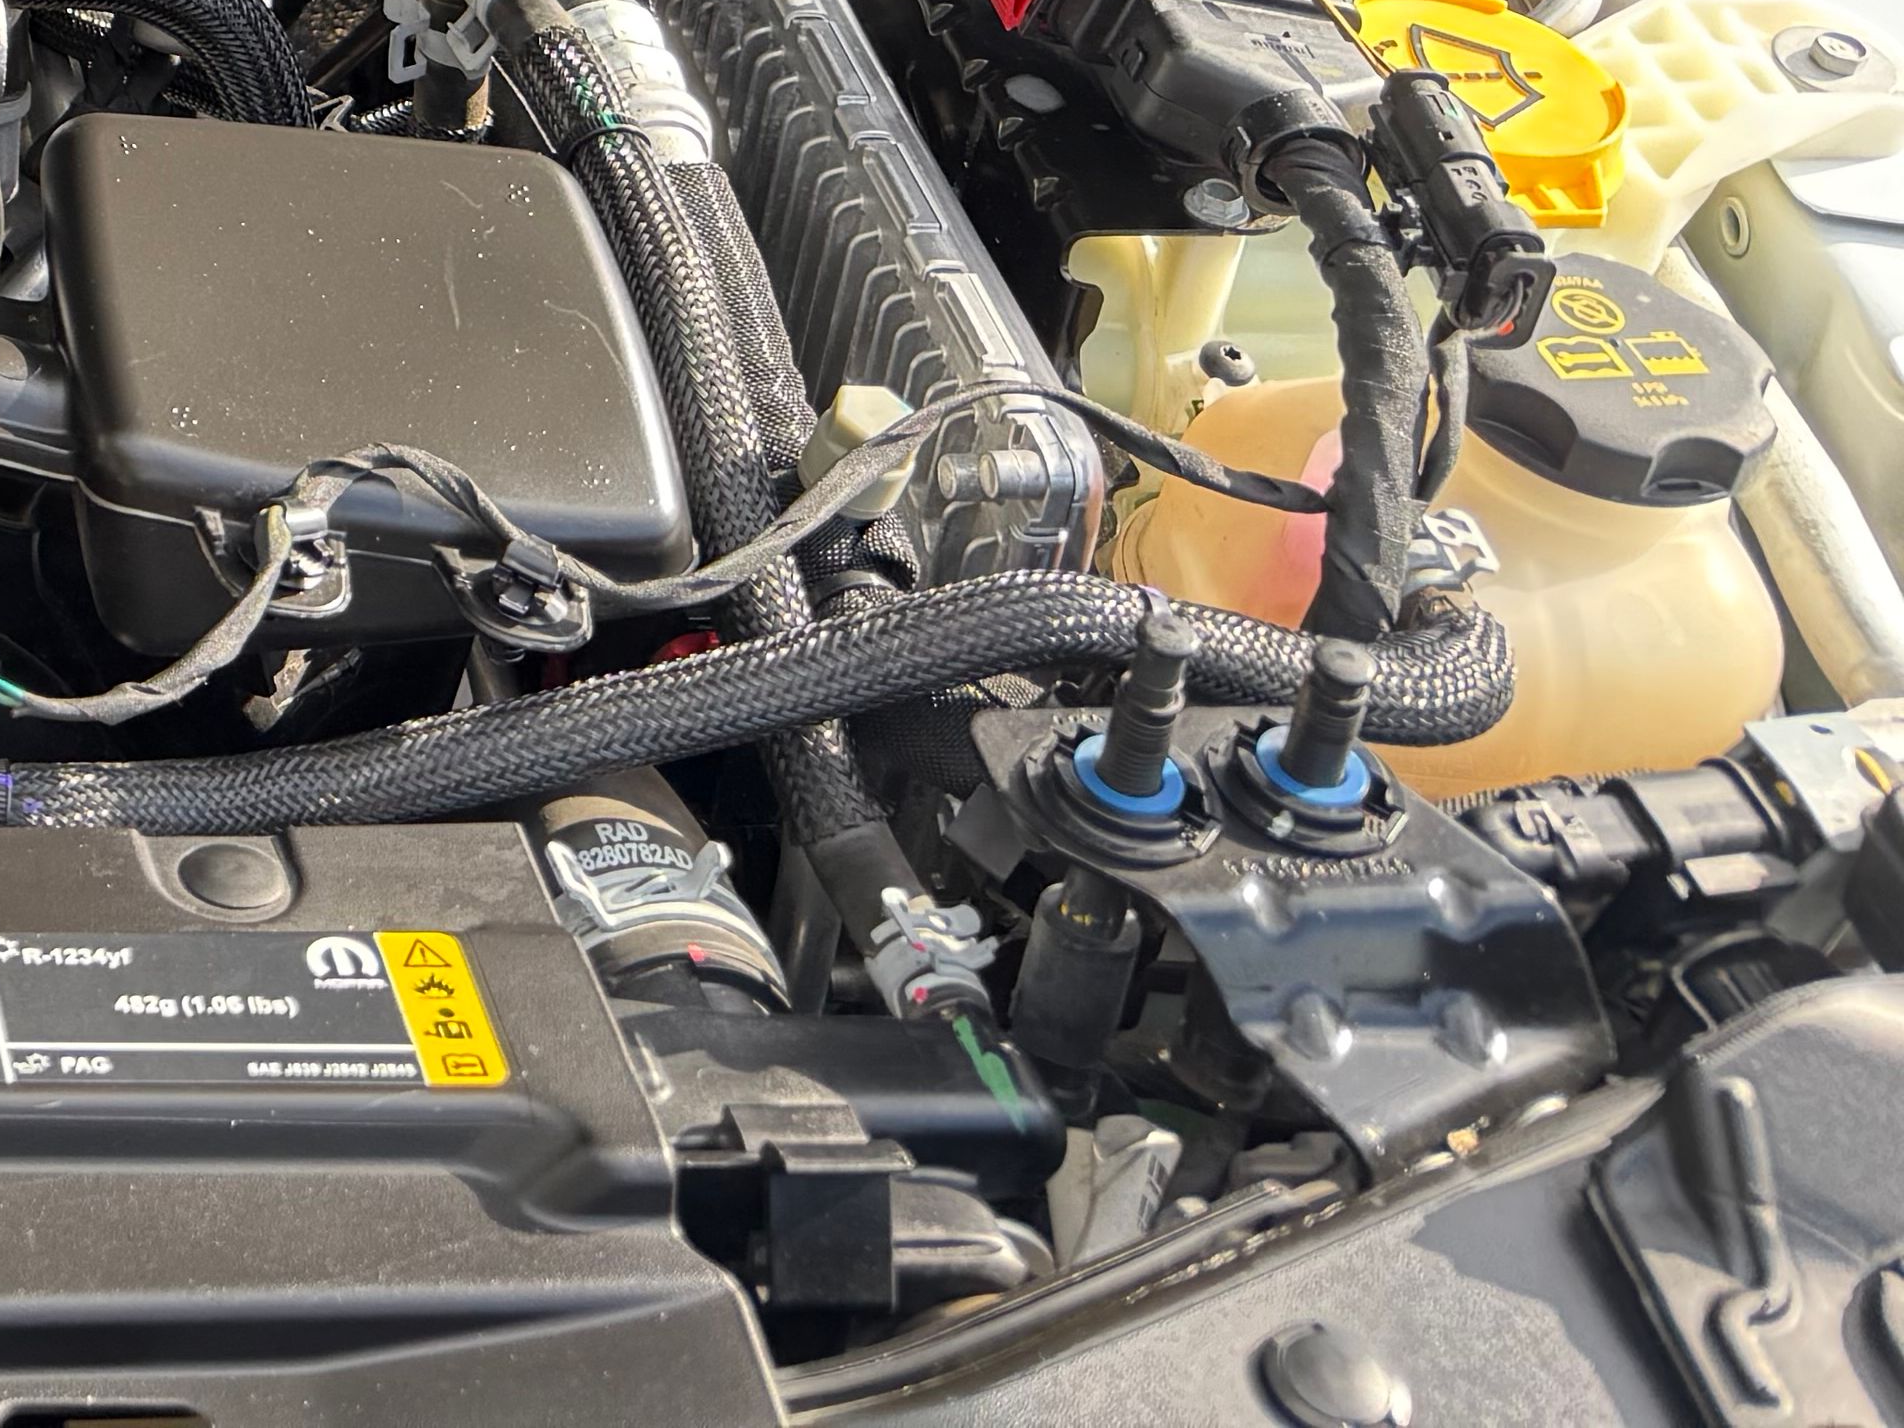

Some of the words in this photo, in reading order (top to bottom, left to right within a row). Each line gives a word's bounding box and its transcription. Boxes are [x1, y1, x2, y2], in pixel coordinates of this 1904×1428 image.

[594, 821, 649, 844] RAD
[576, 841, 694, 872] 8280782AD
[21, 944, 134, 970] R-1234yf
[247, 993, 300, 1020] lbs)
[60, 1055, 114, 1075] PAG
